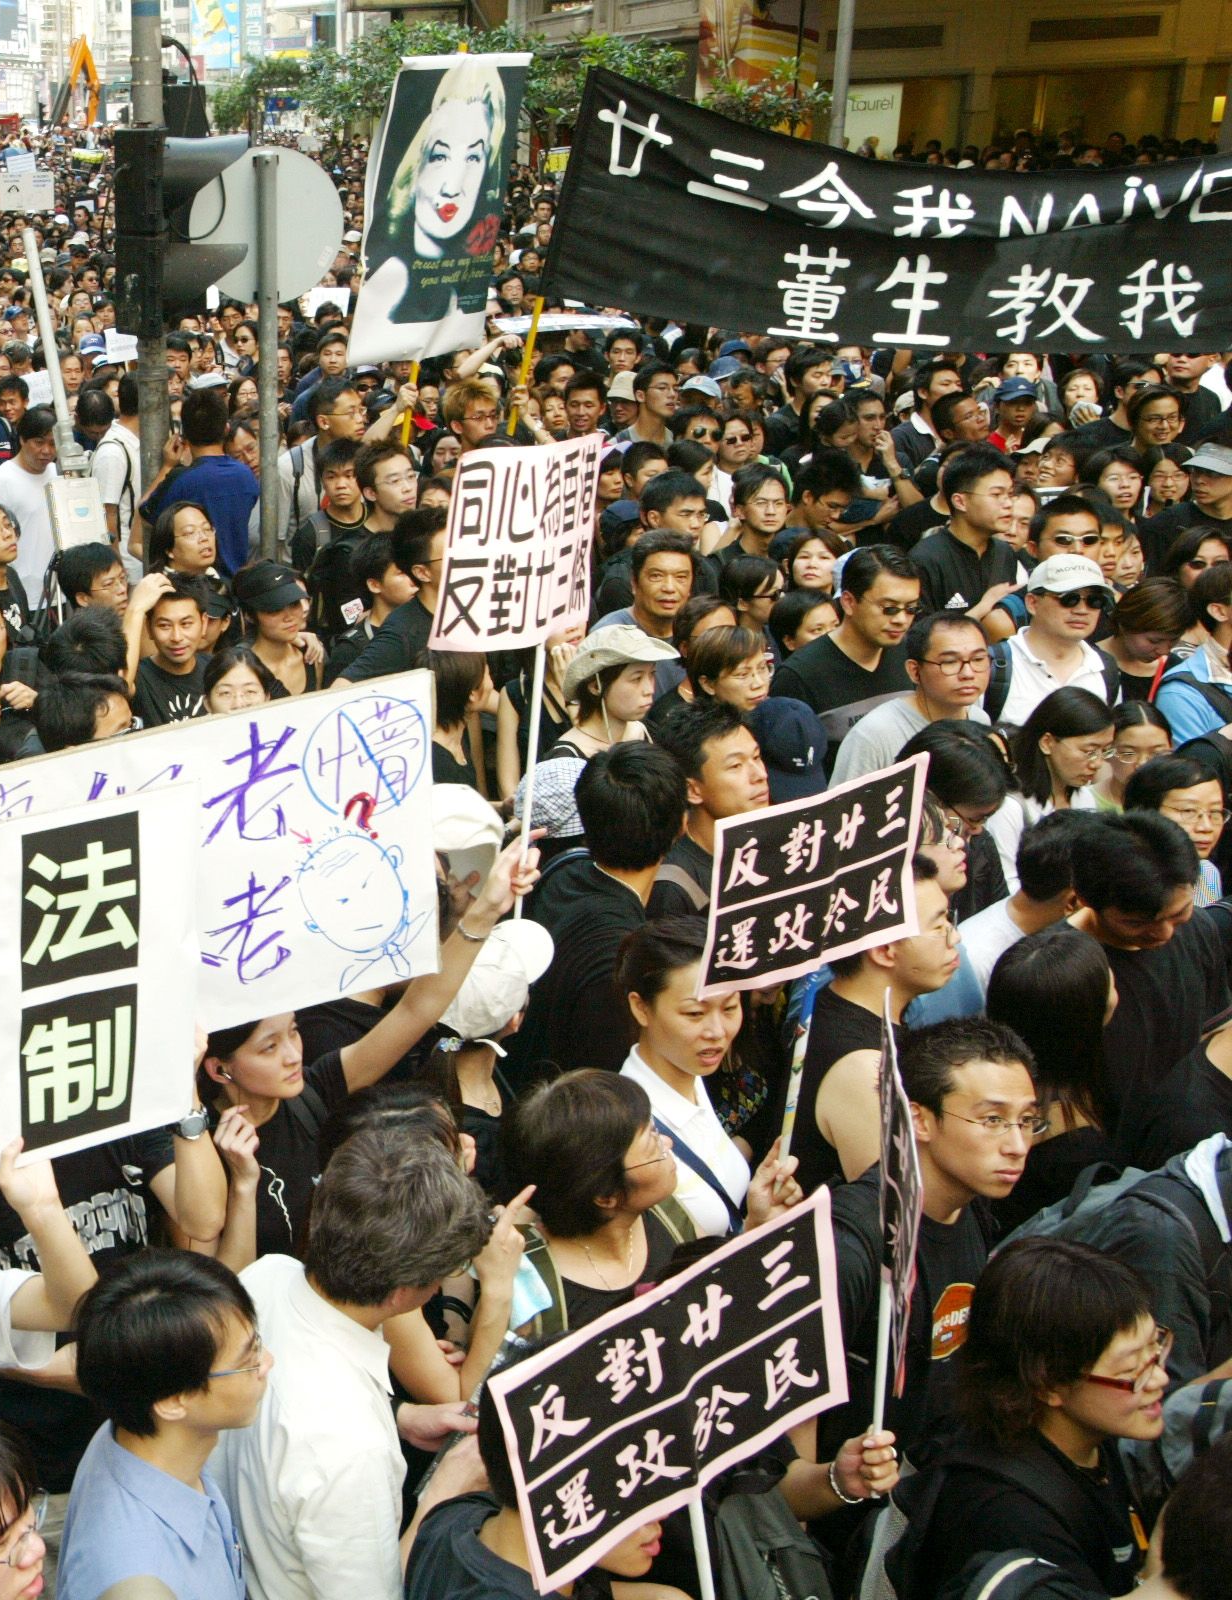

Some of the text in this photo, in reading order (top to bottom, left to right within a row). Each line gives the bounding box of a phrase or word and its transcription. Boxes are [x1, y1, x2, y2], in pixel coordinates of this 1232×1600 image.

[597, 100, 975, 237] 廿三今我
[768, 243, 1203, 345] 董生教我
[724, 786, 906, 892] 反對廿三
[715, 868, 898, 970] 還政於民
[530, 1241, 810, 1462] 反對廿三
[543, 1338, 819, 1549] 還政於民
